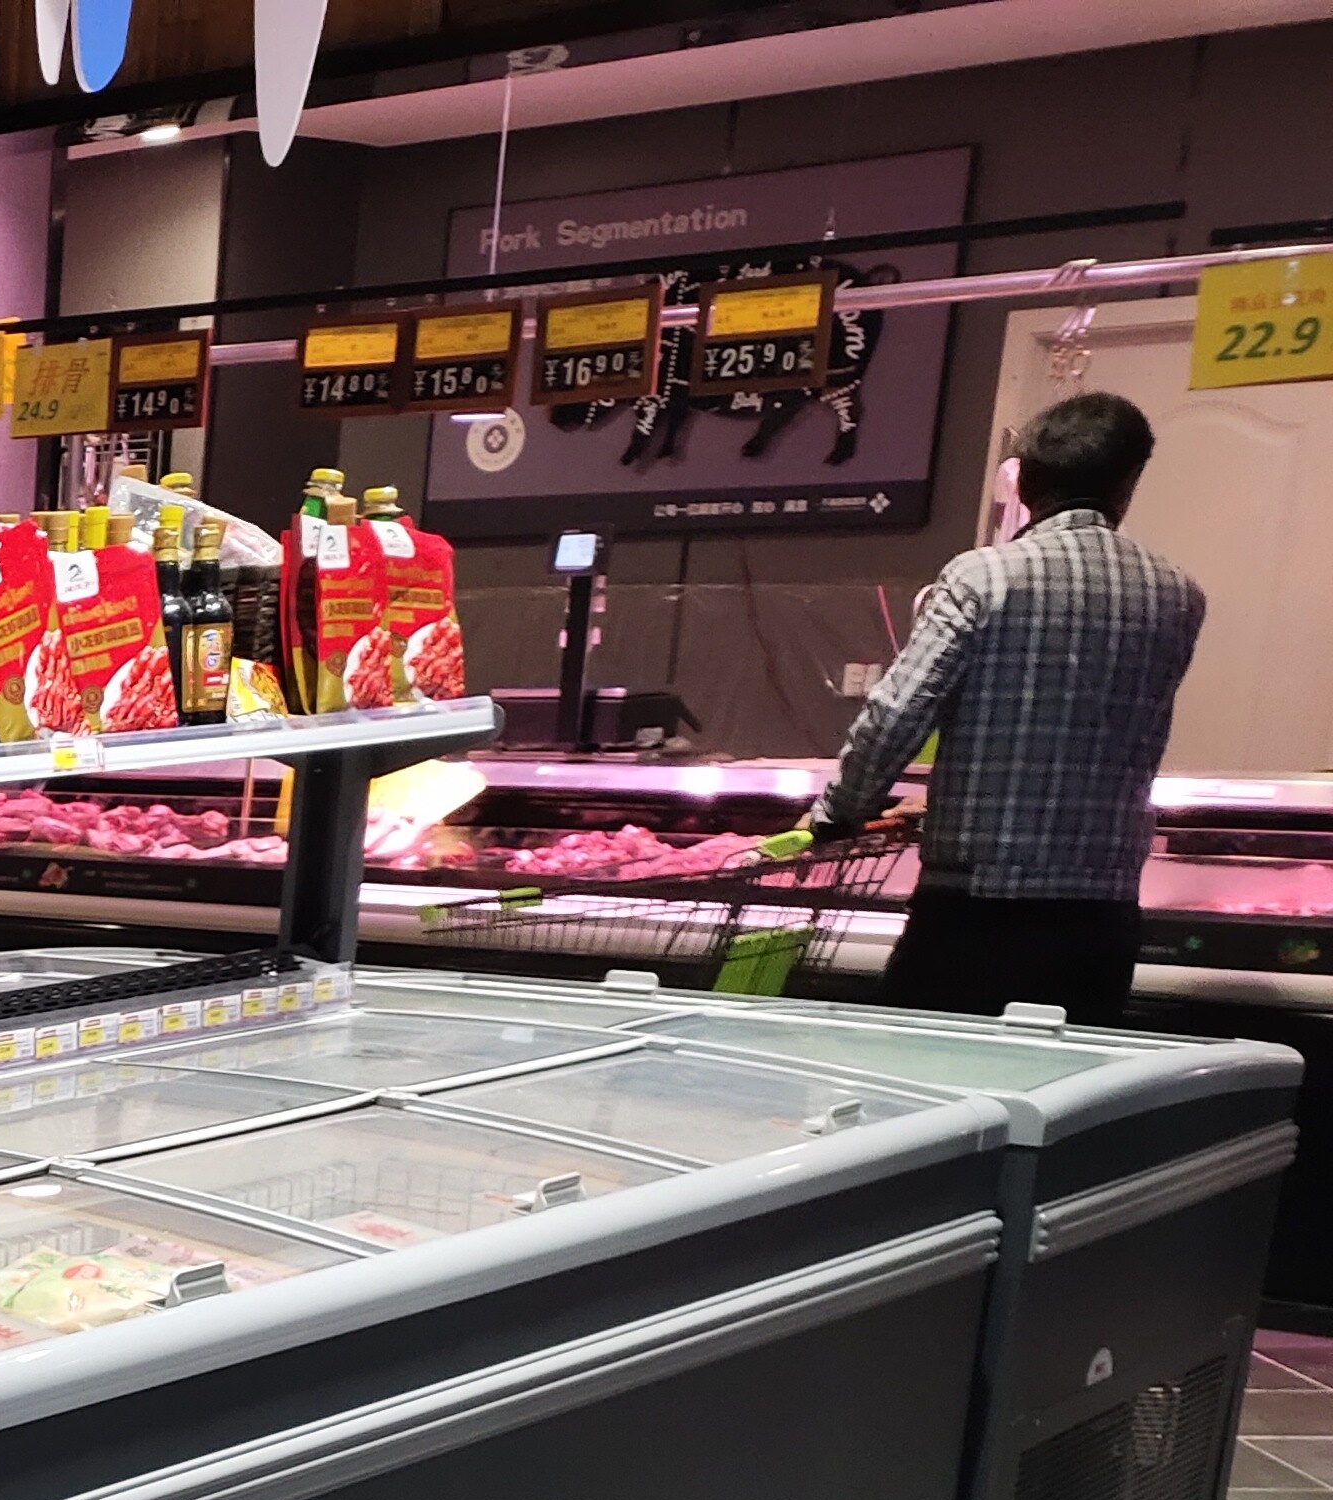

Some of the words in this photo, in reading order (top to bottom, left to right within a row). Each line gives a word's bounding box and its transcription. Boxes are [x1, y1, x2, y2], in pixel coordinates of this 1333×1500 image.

[556, 203, 749, 249] Segmentation
[1215, 316, 1322, 362] 22.9
[29, 357, 90, 396] 排骨
[17, 399, 59, 421] 24.9
